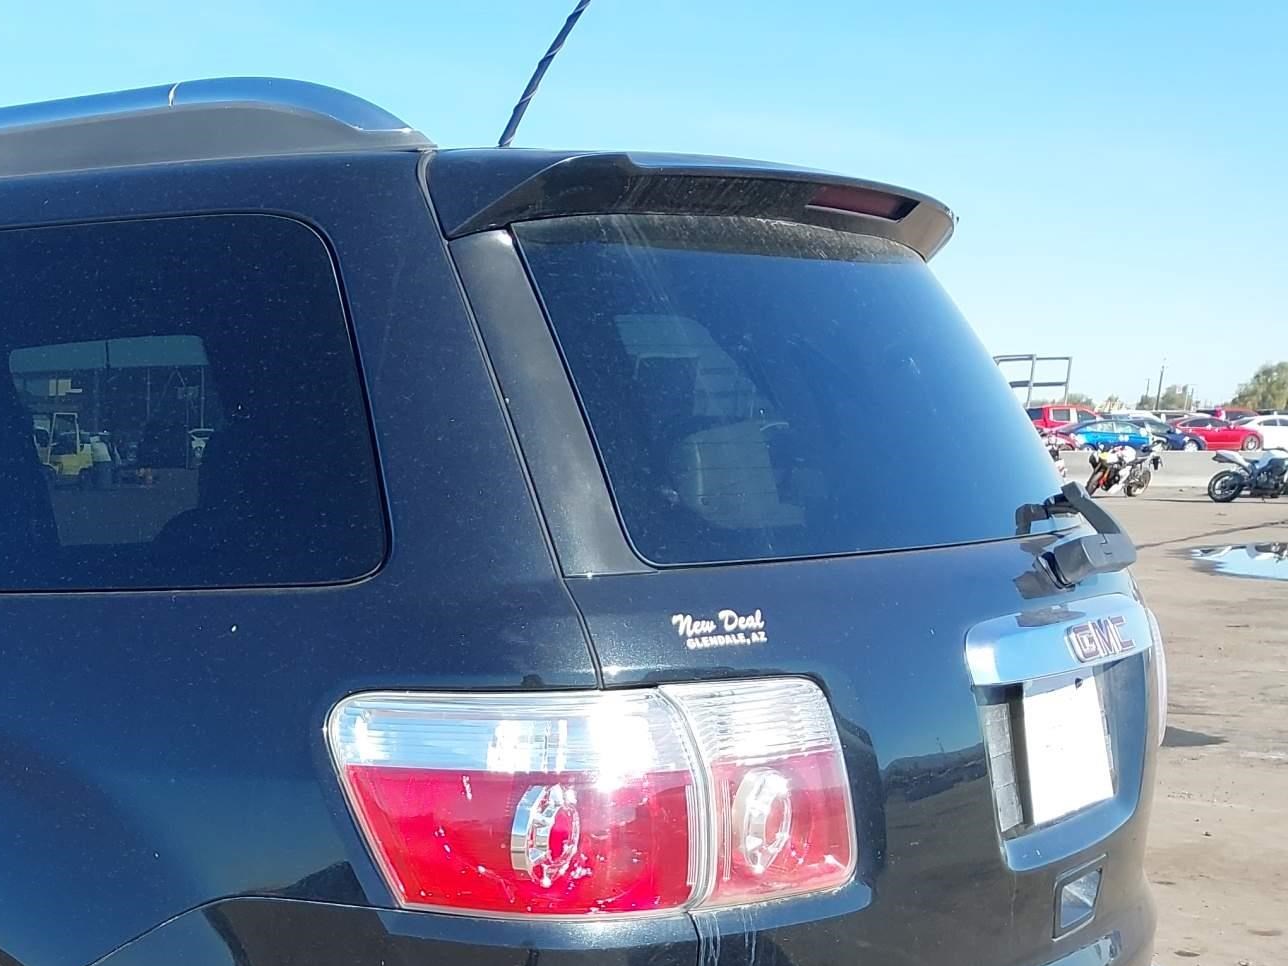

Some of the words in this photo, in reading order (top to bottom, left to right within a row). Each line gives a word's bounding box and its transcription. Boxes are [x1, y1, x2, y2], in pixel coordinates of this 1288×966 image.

[672, 613, 717, 637] New
[718, 609, 765, 632] Deal
[1066, 616, 1135, 663] GMC
